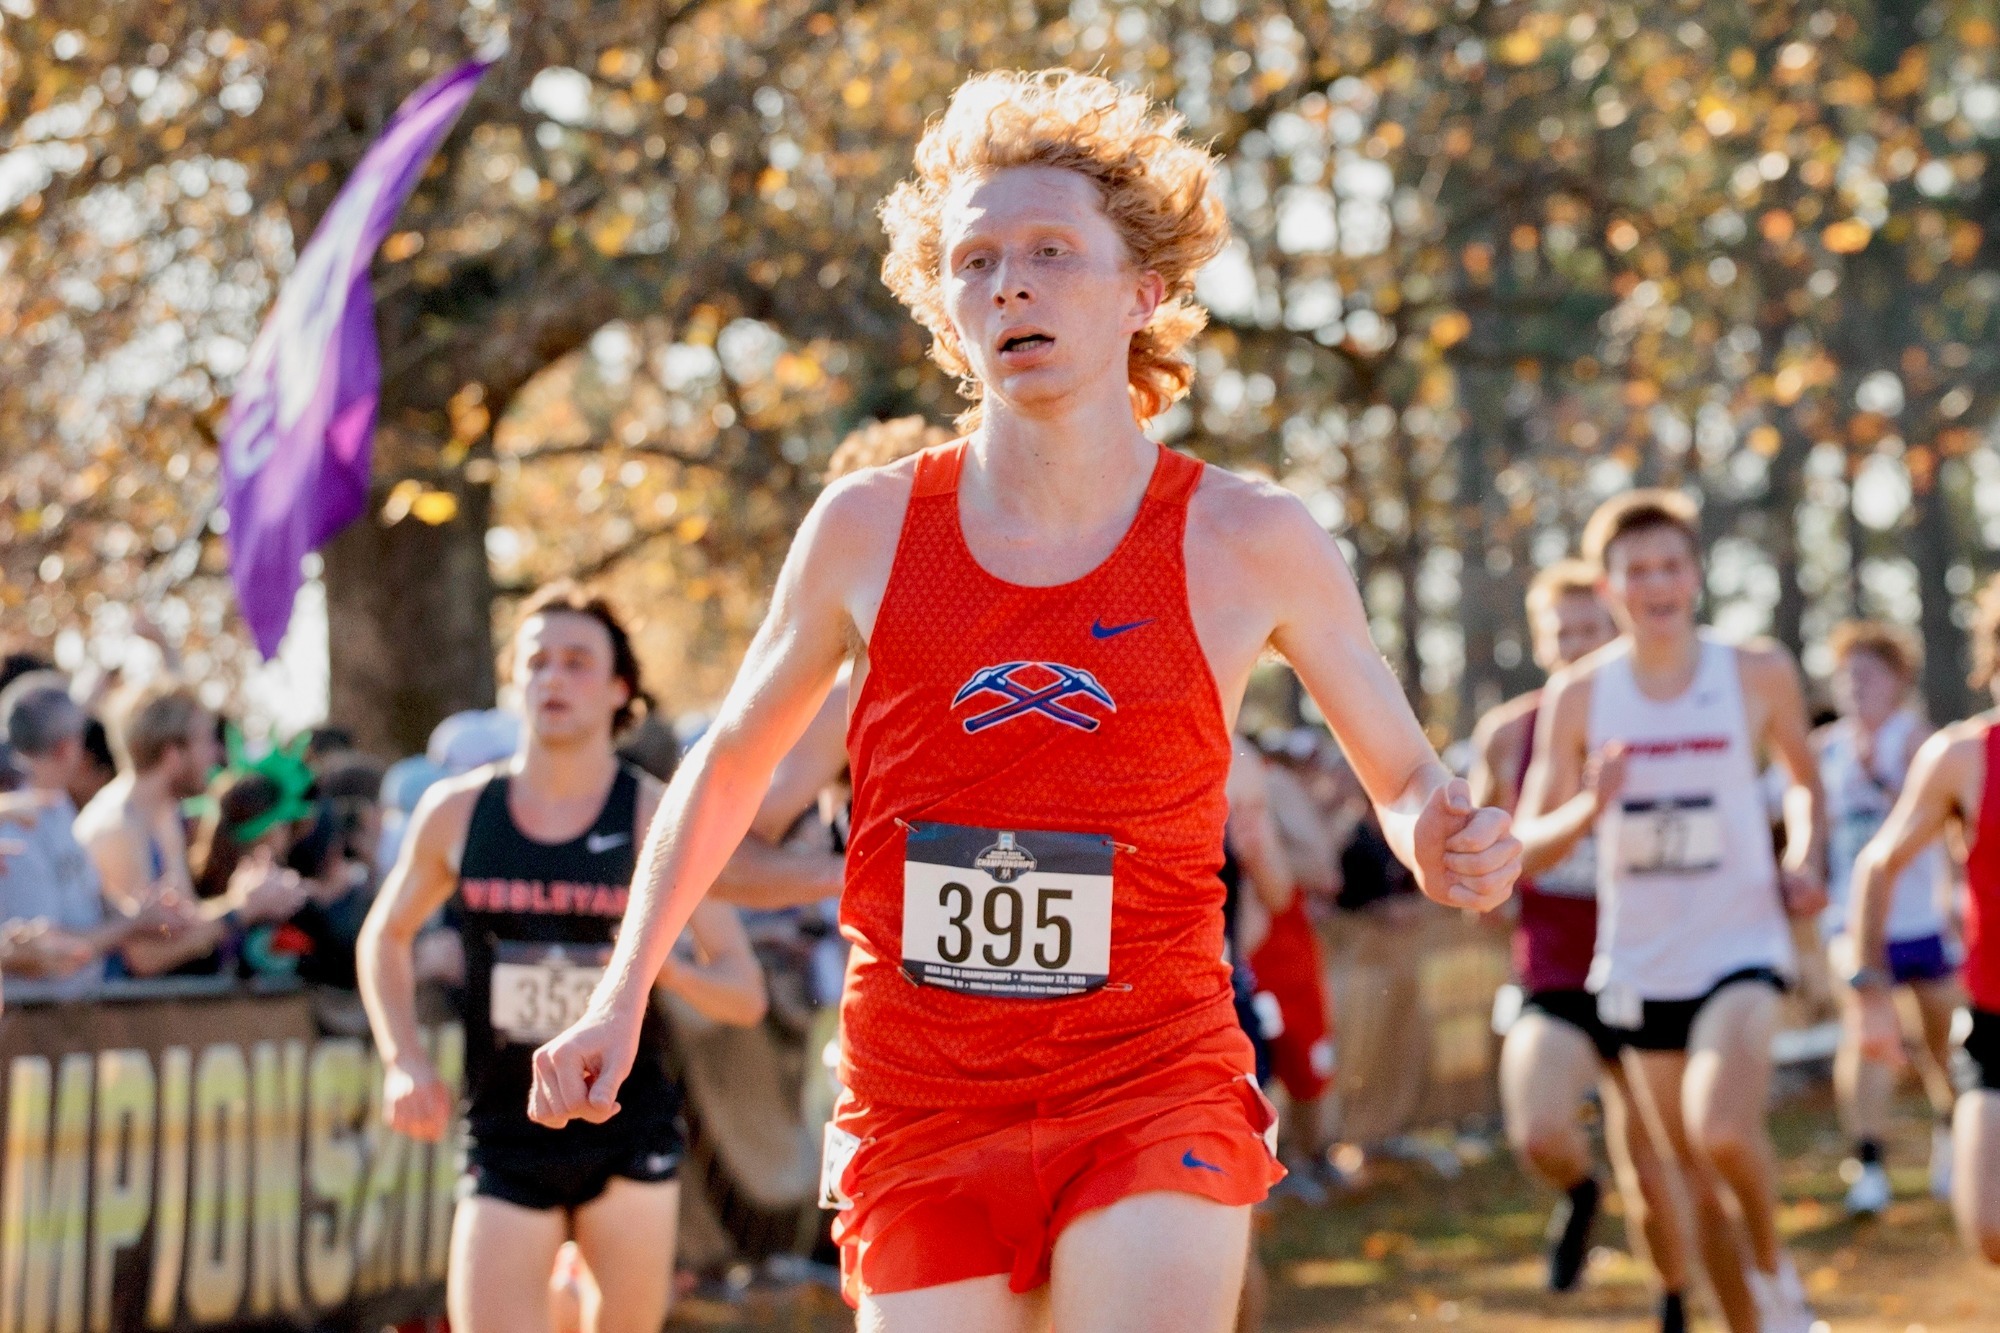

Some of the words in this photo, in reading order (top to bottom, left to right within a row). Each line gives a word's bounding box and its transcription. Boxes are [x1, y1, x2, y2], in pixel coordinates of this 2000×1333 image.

[977, 858, 1035, 869] CHAMPIONSHIPS
[937, 881, 1073, 970] 395
[961, 969, 1012, 982] CHAMPIONSHIPS
[1020, 973, 1055, 983] November
